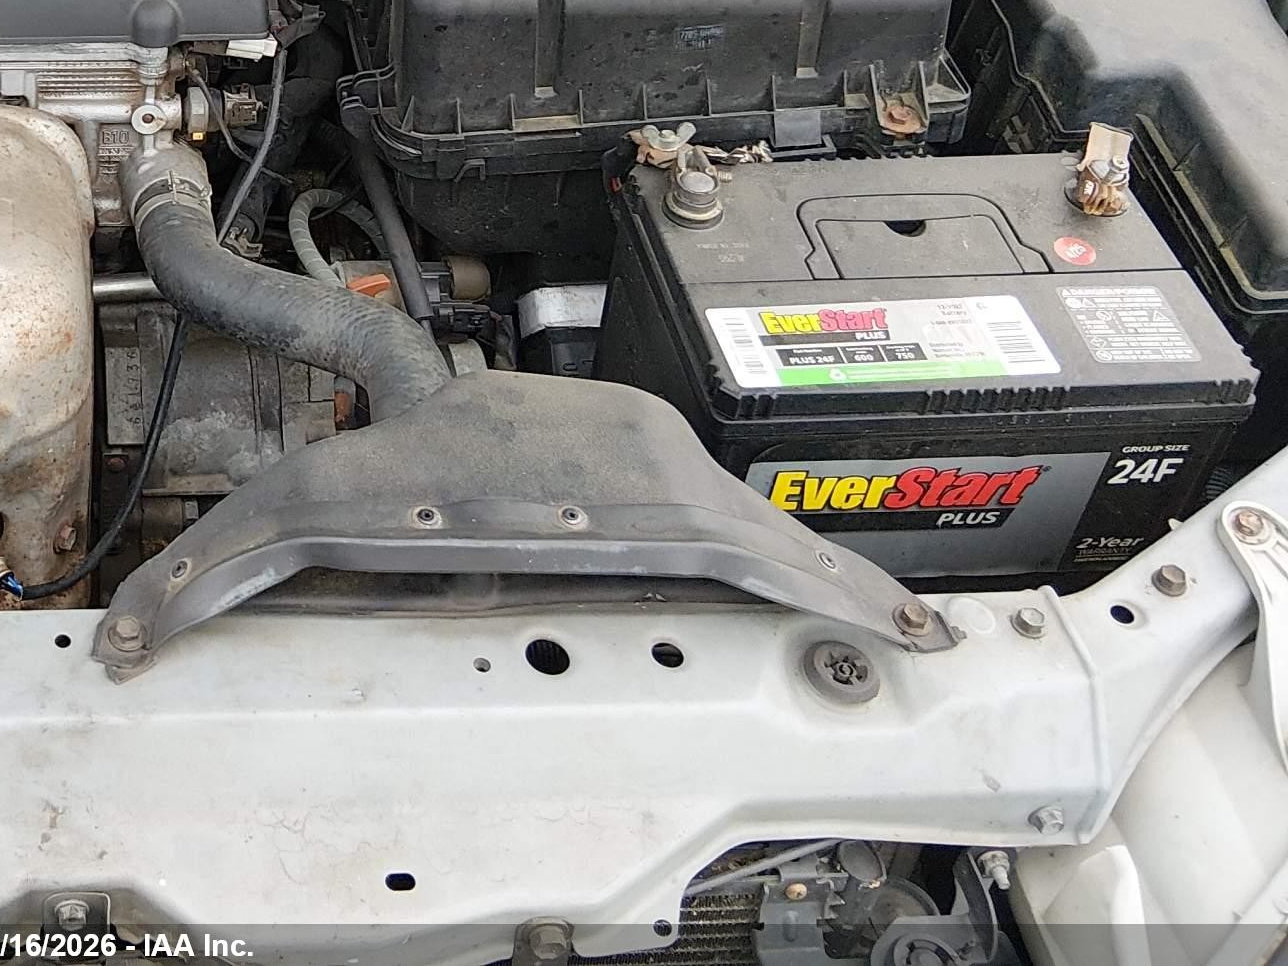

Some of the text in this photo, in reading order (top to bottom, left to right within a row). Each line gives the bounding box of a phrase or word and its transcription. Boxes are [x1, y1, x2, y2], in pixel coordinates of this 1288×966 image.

[758, 307, 889, 334] EverStart
[854, 331, 886, 340] PLUS
[788, 356, 816, 365] PLUS
[1122, 444, 1191, 453] GROUP SIZE
[1107, 458, 1184, 484] 24F
[769, 465, 1044, 511] EverStart
[936, 511, 1001, 527] PLUS
[1076, 537, 1145, 549] 2-Year
